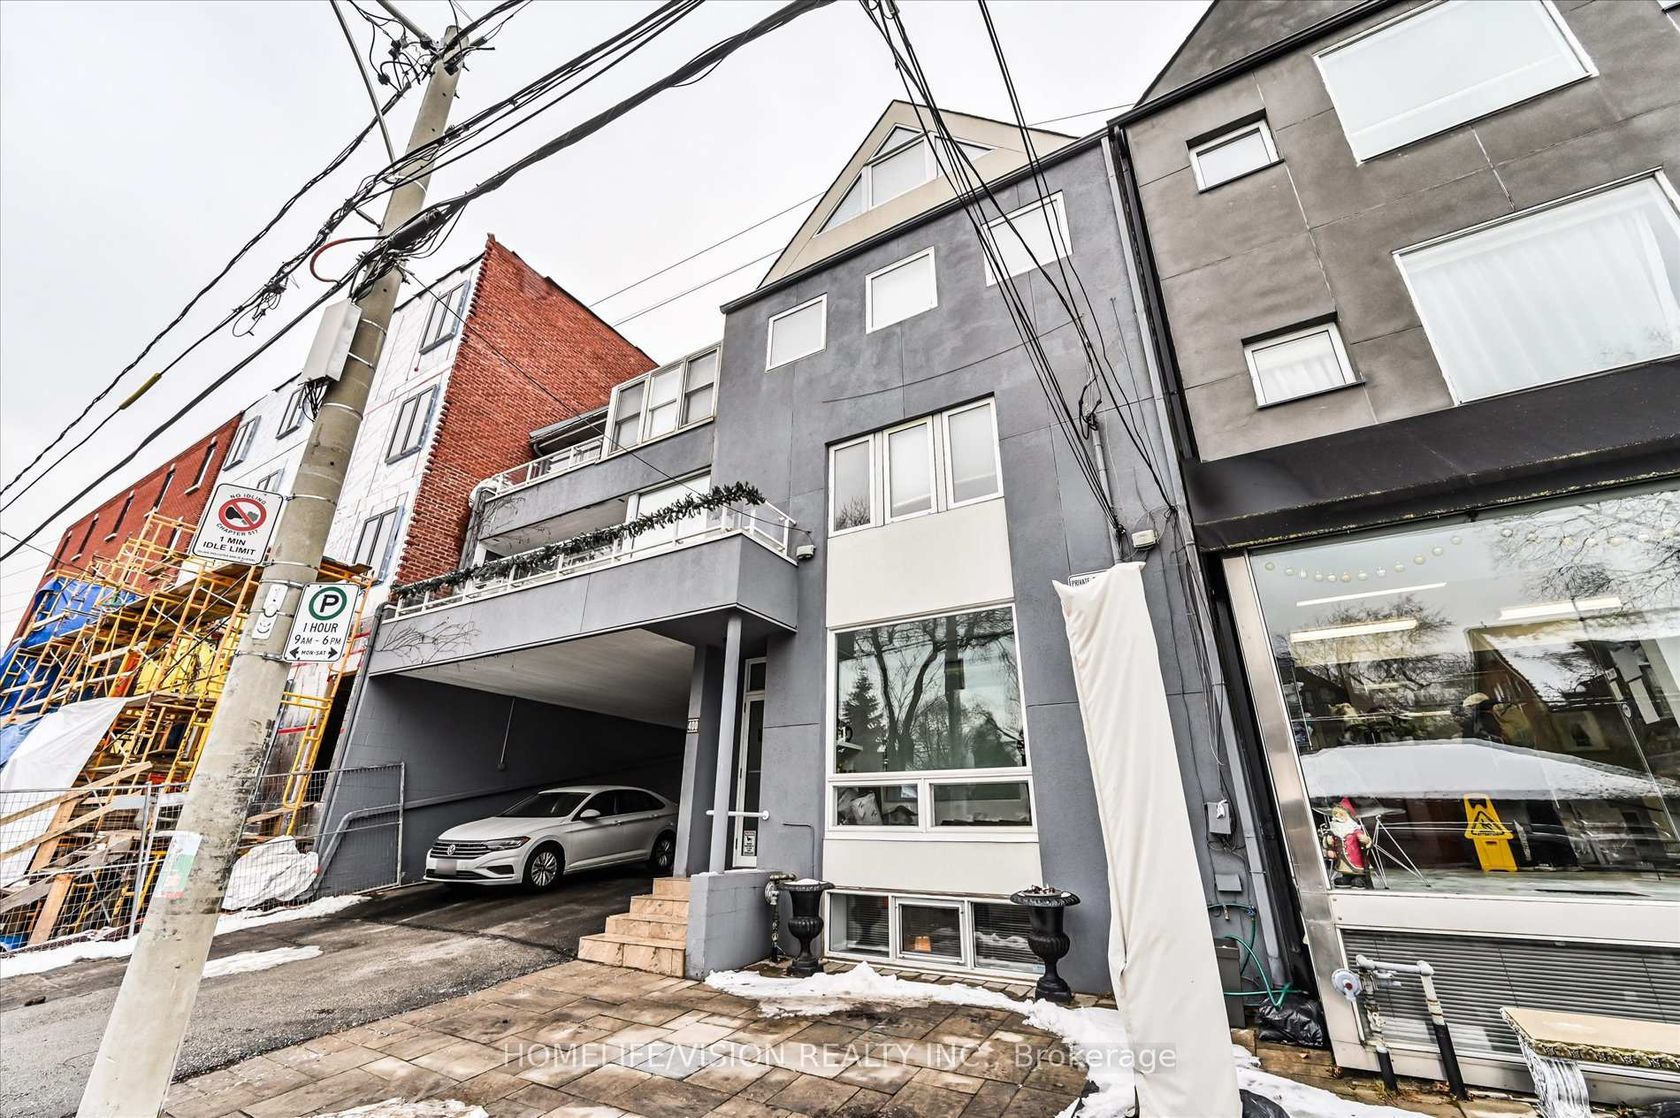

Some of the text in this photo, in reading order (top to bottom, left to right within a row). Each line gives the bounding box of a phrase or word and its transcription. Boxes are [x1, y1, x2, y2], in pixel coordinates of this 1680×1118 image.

[243, 493, 267, 505] IDLING
[216, 523, 246, 536] CHAPTER
[227, 537, 246, 546] MIN
[202, 541, 227, 551] IDLE
[229, 545, 256, 556] LIMIT
[320, 594, 339, 613] P
[303, 622, 339, 633] 1 HOUR
